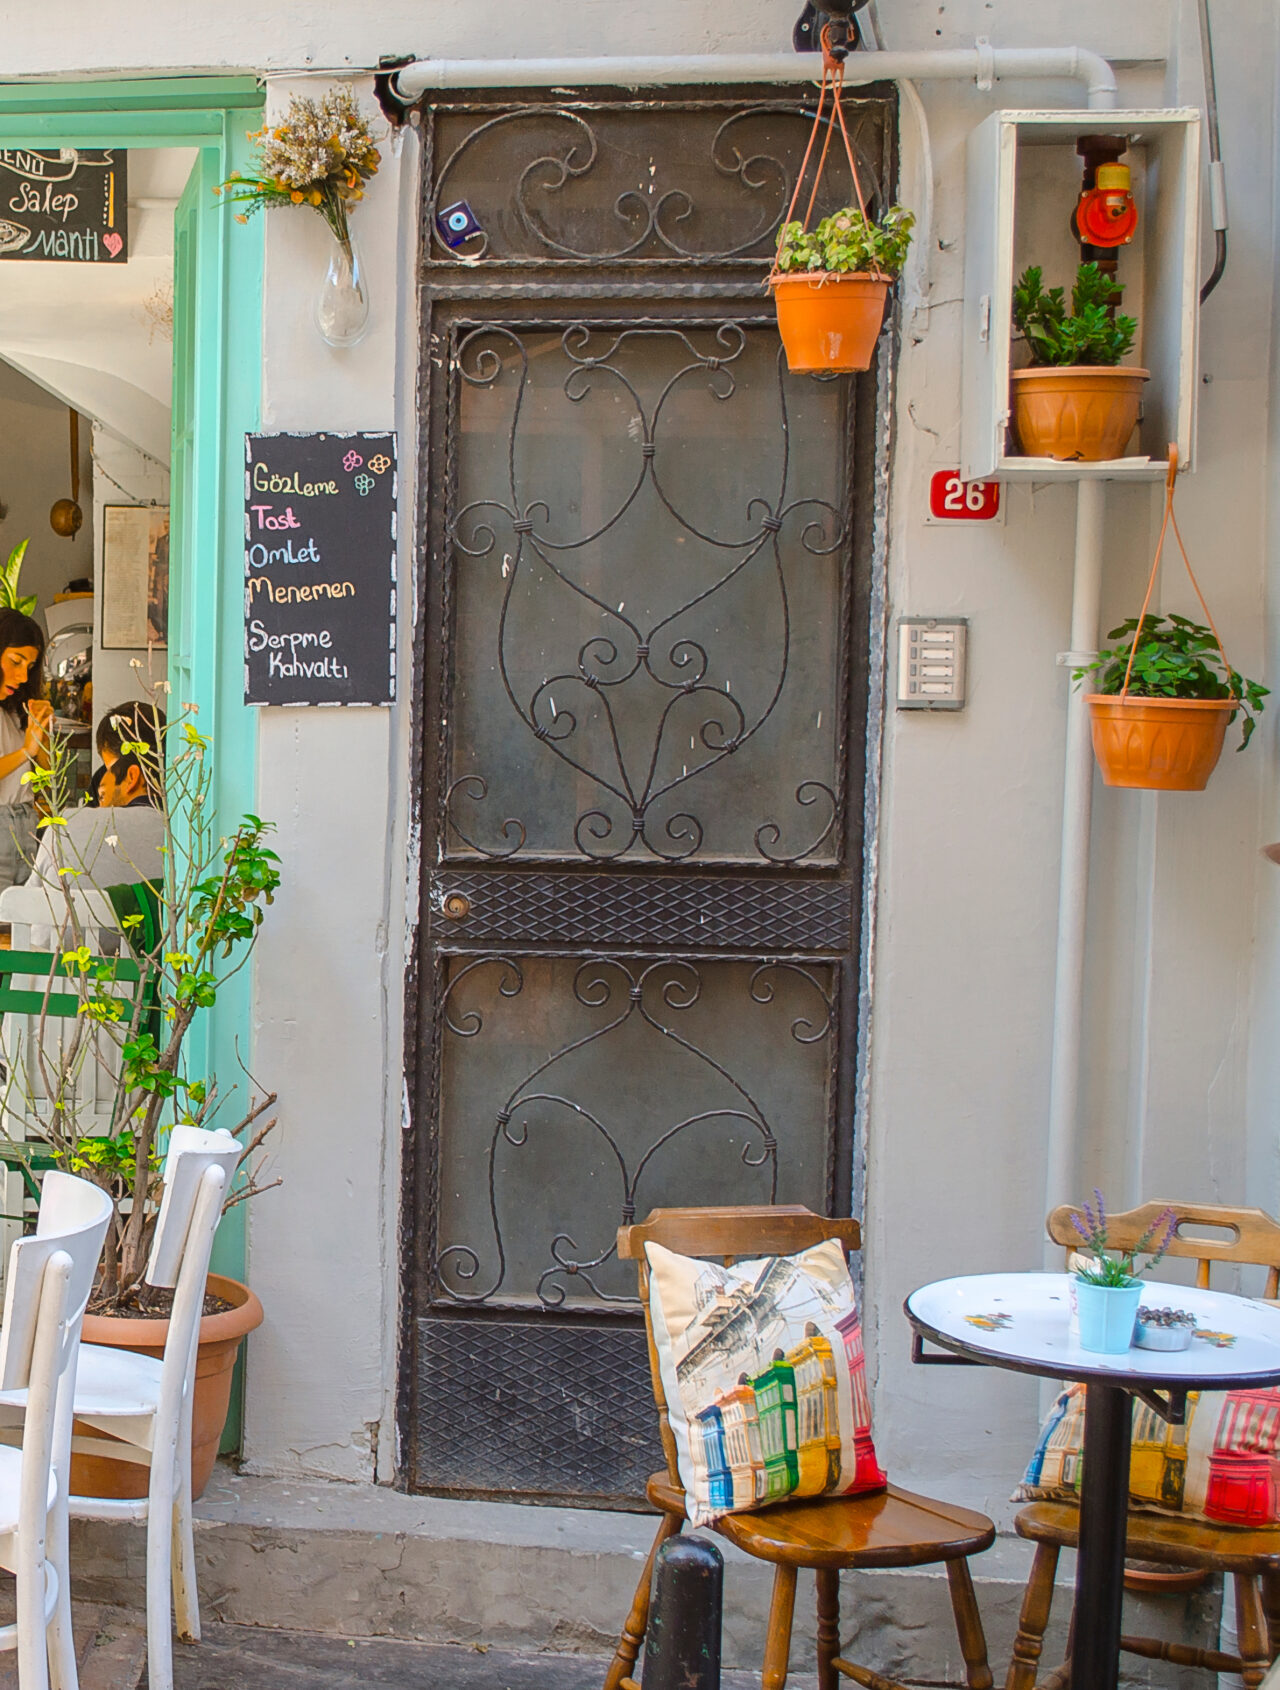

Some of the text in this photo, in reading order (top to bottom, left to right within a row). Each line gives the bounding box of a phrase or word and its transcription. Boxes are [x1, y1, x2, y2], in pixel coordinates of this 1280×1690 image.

[9, 182, 78, 222] Salep
[253, 462, 339, 497] Gözleme
[944, 478, 985, 511] 26
[250, 505, 301, 530] Tost
[249, 538, 320, 568] Omlet
[248, 576, 356, 604] Menemen
[249, 620, 333, 654] Serpme
